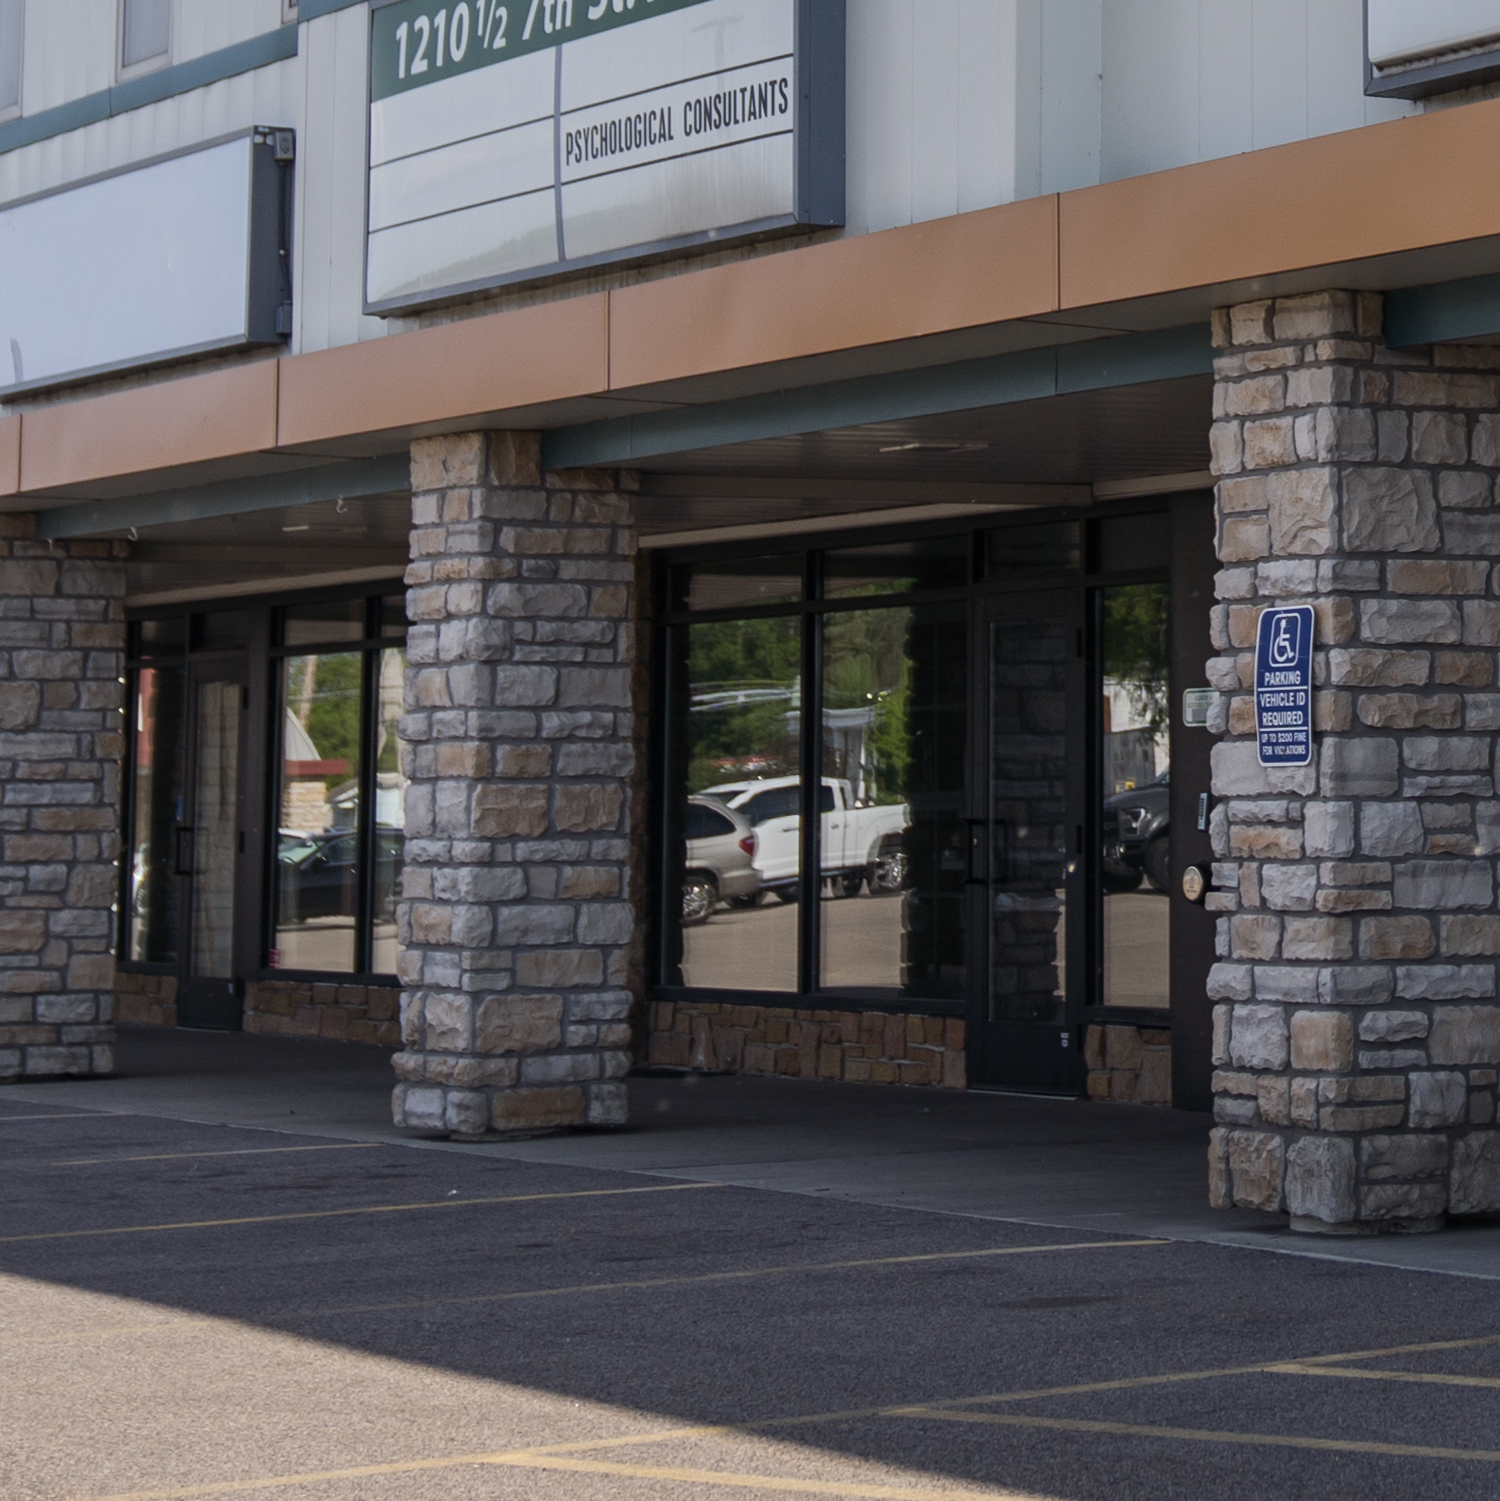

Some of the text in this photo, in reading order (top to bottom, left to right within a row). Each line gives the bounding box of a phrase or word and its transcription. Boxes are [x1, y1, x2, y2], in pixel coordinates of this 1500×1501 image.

[565, 77, 789, 166] PSYCHOLOGICAL CONSULTANTS
[1263, 670, 1302, 687] PARKING
[1259, 691, 1306, 708] VEHICLE ID
[1261, 710, 1304, 726] REQUIRED
[1260, 732, 1307, 743] UP TO $200 FINE
[1262, 746, 1273, 756] FOR
